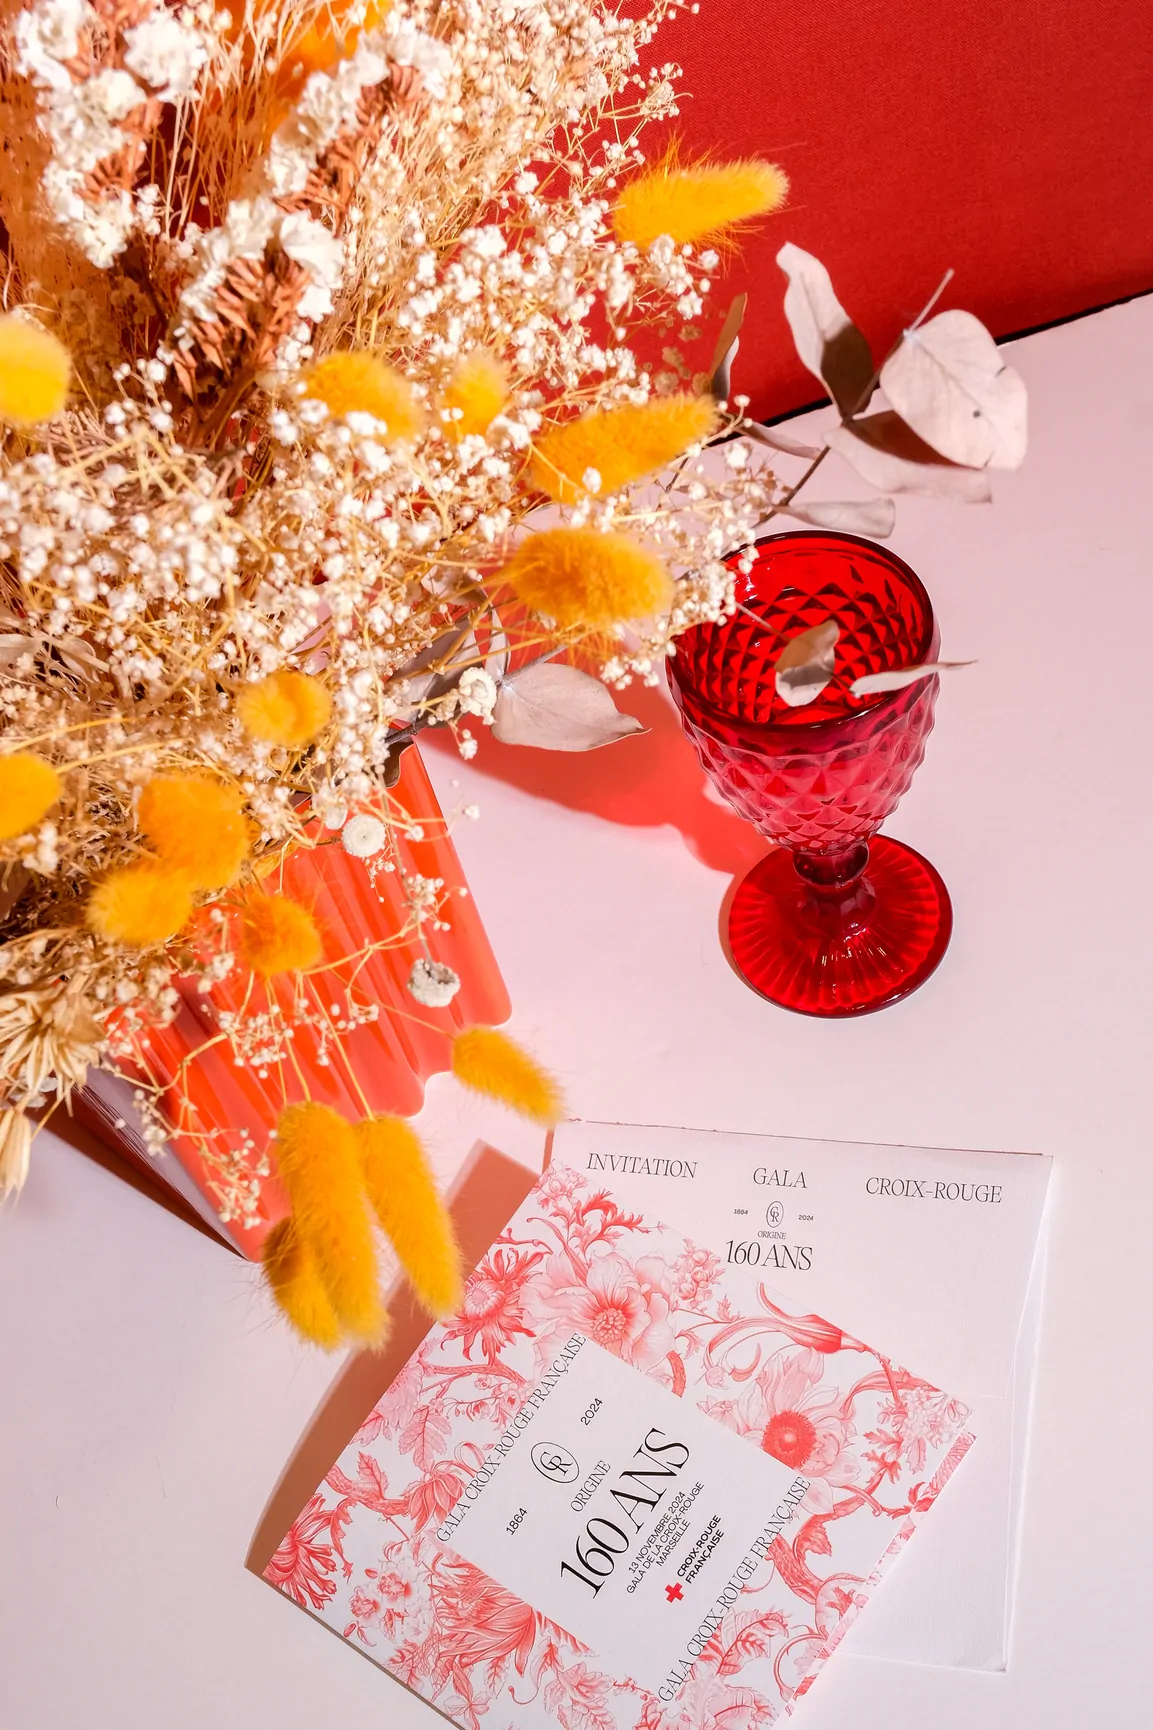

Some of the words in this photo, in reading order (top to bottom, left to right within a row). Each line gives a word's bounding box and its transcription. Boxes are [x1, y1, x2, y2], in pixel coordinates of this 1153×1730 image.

[586, 1152, 698, 1179] INVITATION
[752, 1167, 808, 1189] GALA
[865, 1177, 1003, 1204] CROIX-ROUGE
[726, 1240, 761, 1266] 160
[760, 1244, 813, 1271] ANS
[757, 1230, 786, 1240] ORIGINE
[436, 1502, 470, 1542] GALA
[465, 1407, 534, 1500] CROIX-ROUGE
[527, 1332, 586, 1410] FRANÇAISE
[580, 1398, 603, 1426] 2024
[570, 1460, 611, 1512] ORIGINE
[505, 1508, 528, 1535] 1864
[561, 1517, 630, 1599] 160
[609, 1428, 690, 1534] ANS
[626, 1570, 646, 1593] GALA
[643, 1555, 655, 1569] DE
[651, 1544, 664, 1558] LA
[660, 1481, 705, 1543] CROIX-ROUGE
[628, 1561, 639, 1574] 13
[636, 1513, 671, 1562] NOVEMBRE
[668, 1491, 686, 1514] 2024
[656, 1519, 691, 1566] MARSEILLE
[677, 1514, 722, 1577] CROIX-ROUGE
[685, 1529, 725, 1584] FRANÇAISE
[658, 1659, 694, 1702] GALA
[686, 1556, 758, 1657] CROIX-ROUGE
[750, 1476, 811, 1560] FRANÇAISE
